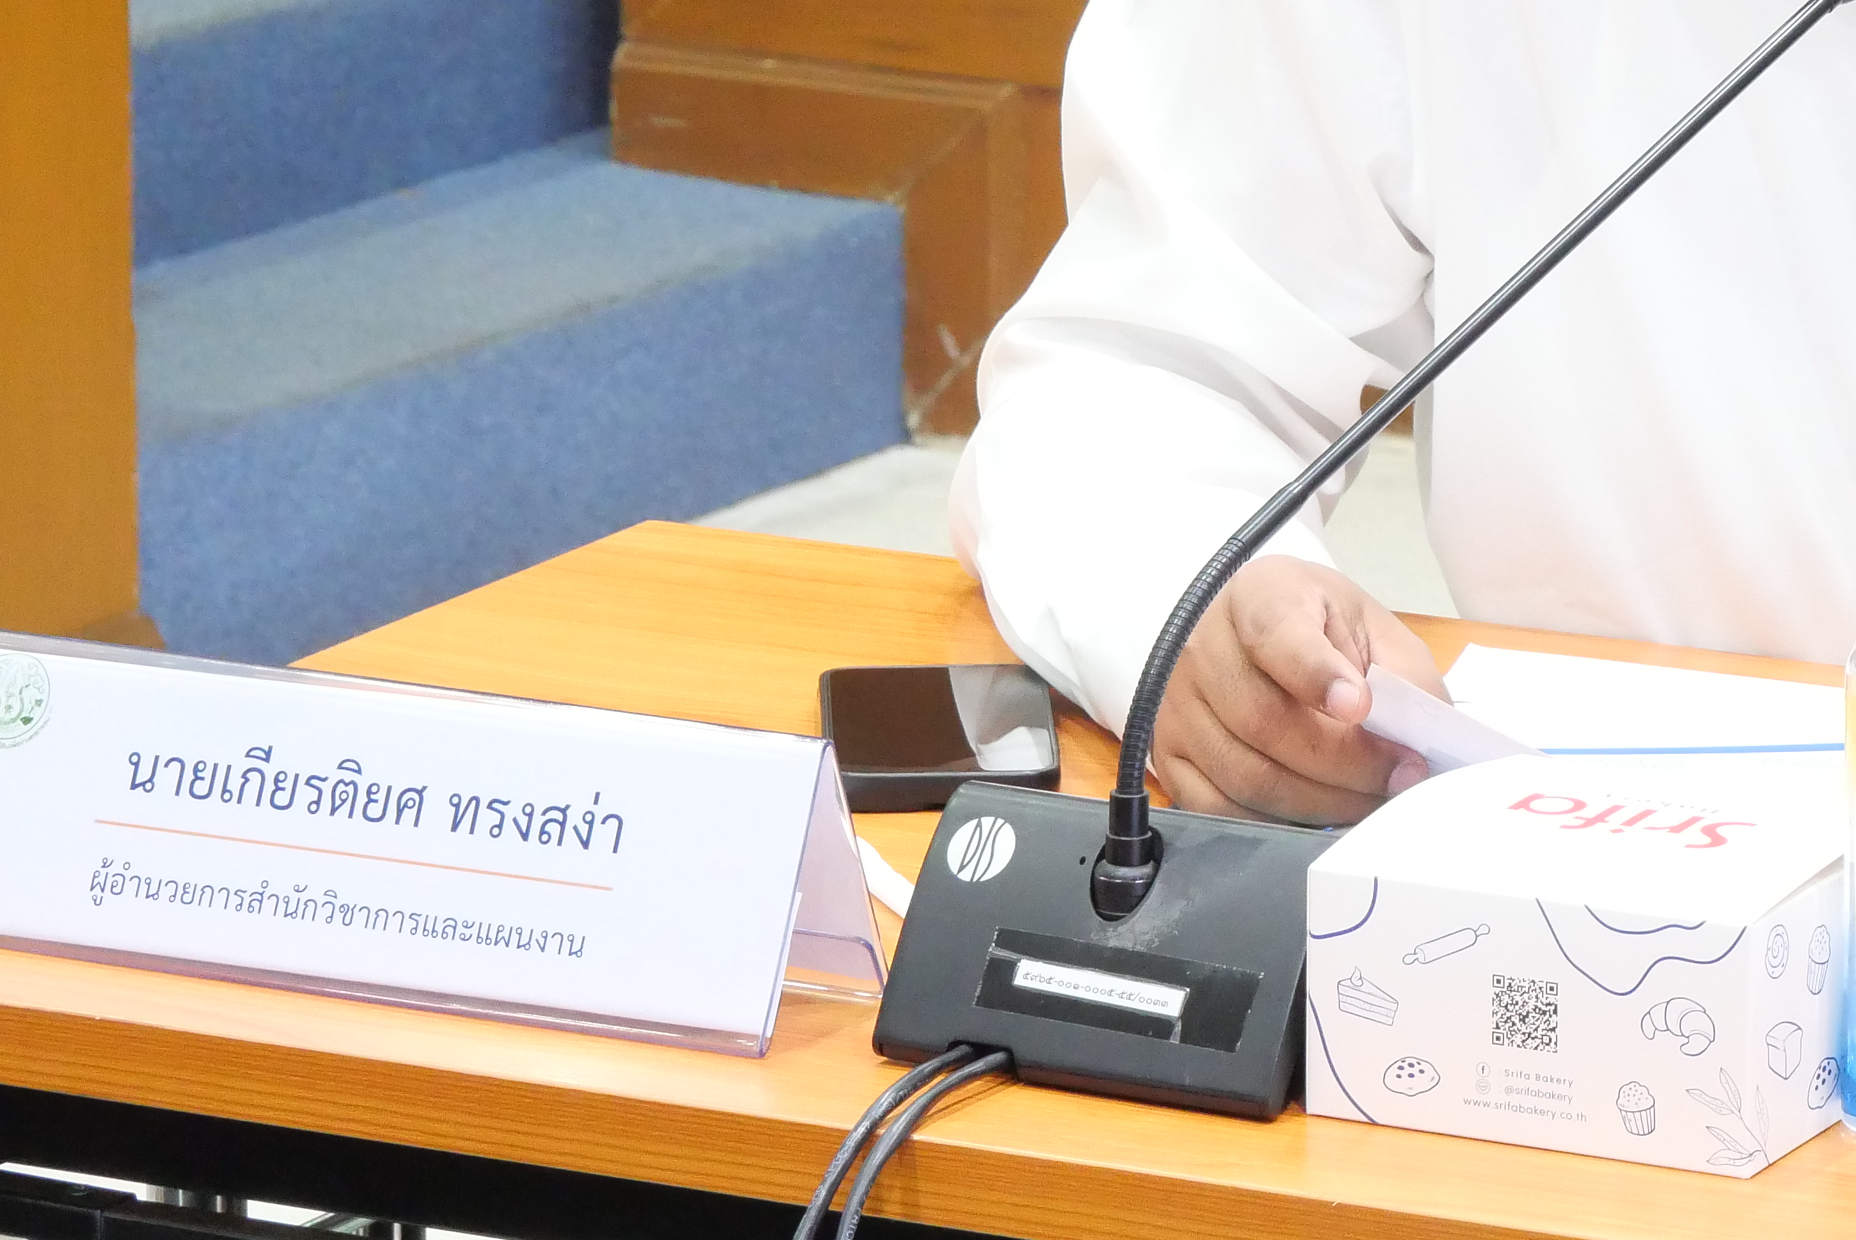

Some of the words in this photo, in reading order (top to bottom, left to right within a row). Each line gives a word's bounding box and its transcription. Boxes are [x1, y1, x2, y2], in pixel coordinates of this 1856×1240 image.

[128, 744, 430, 828] นายเกียรติยศ
[448, 791, 624, 855] ทรงสง่า
[1506, 792, 1758, 849] Srifa
[89, 856, 586, 959] ผู้อำนวยการสำนักวิชาการและแผนงาน
[1504, 1068, 1531, 1081] Srifa
[1534, 1072, 1574, 1089] Bakery
[1504, 1085, 1574, 1105] @srifabakery
[1462, 1096, 1587, 1123] www.srifabakery.co.th
